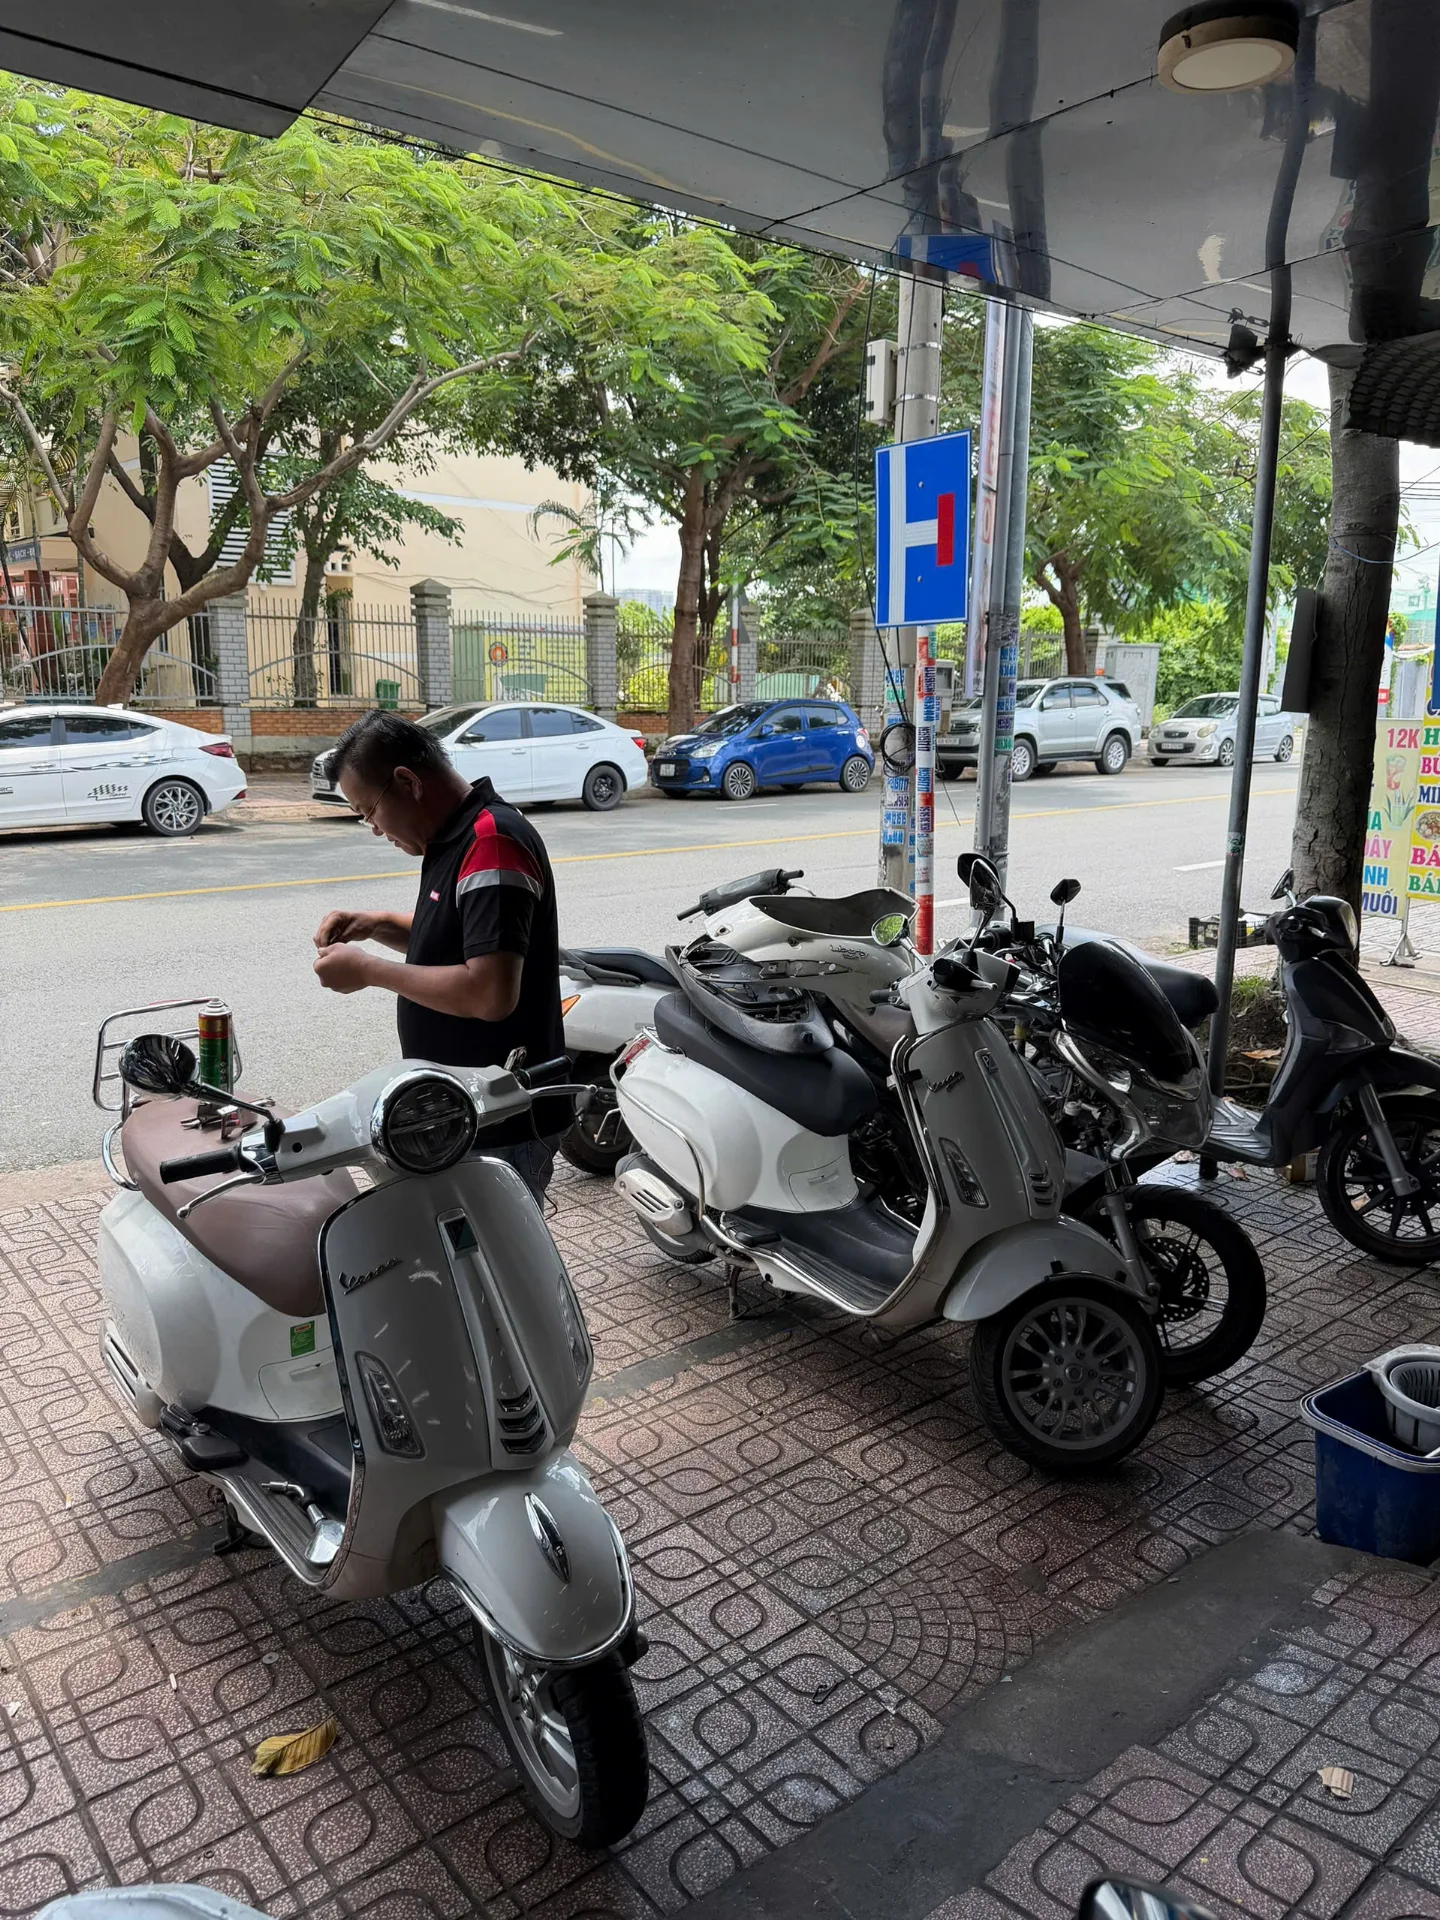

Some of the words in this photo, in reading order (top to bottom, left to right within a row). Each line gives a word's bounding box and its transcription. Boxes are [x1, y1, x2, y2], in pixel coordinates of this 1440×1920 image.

[1387, 728, 1420, 749] 12K
[1418, 785, 1440, 804] MI
[1363, 865, 1388, 887] NH
[1408, 873, 1440, 895] BÁ
[338, 1256, 403, 1296] Vespa
